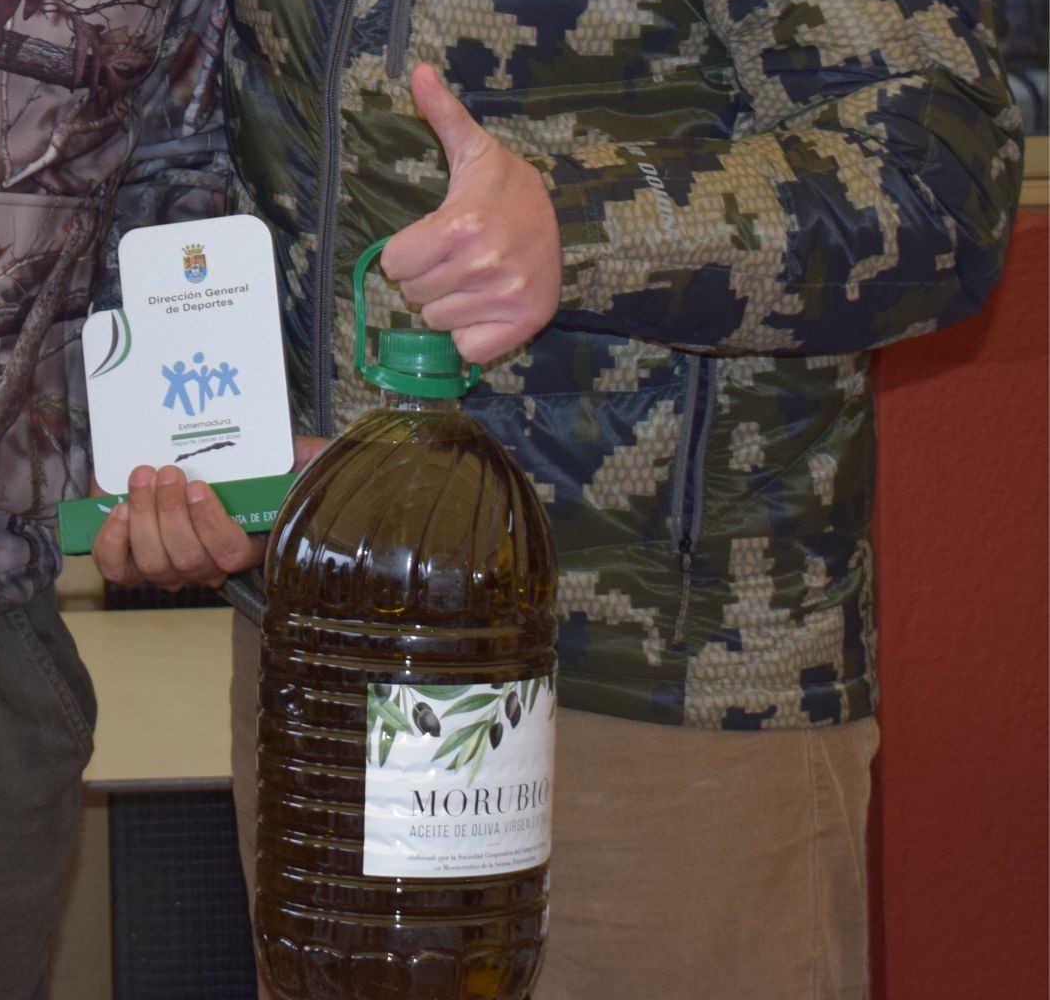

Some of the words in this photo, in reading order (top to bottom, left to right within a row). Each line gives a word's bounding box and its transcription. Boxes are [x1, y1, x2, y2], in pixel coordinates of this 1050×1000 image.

[148, 290, 202, 305] Dirección
[205, 283, 249, 298] General
[166, 305, 179, 314] de
[182, 298, 234, 312] Deportes
[178, 419, 231, 431] Extremadura
[409, 777, 549, 817] MORUBIO
[410, 824, 449, 838] ACEITE
[454, 824, 467, 838] DE
[472, 822, 500, 837] OLIVA
